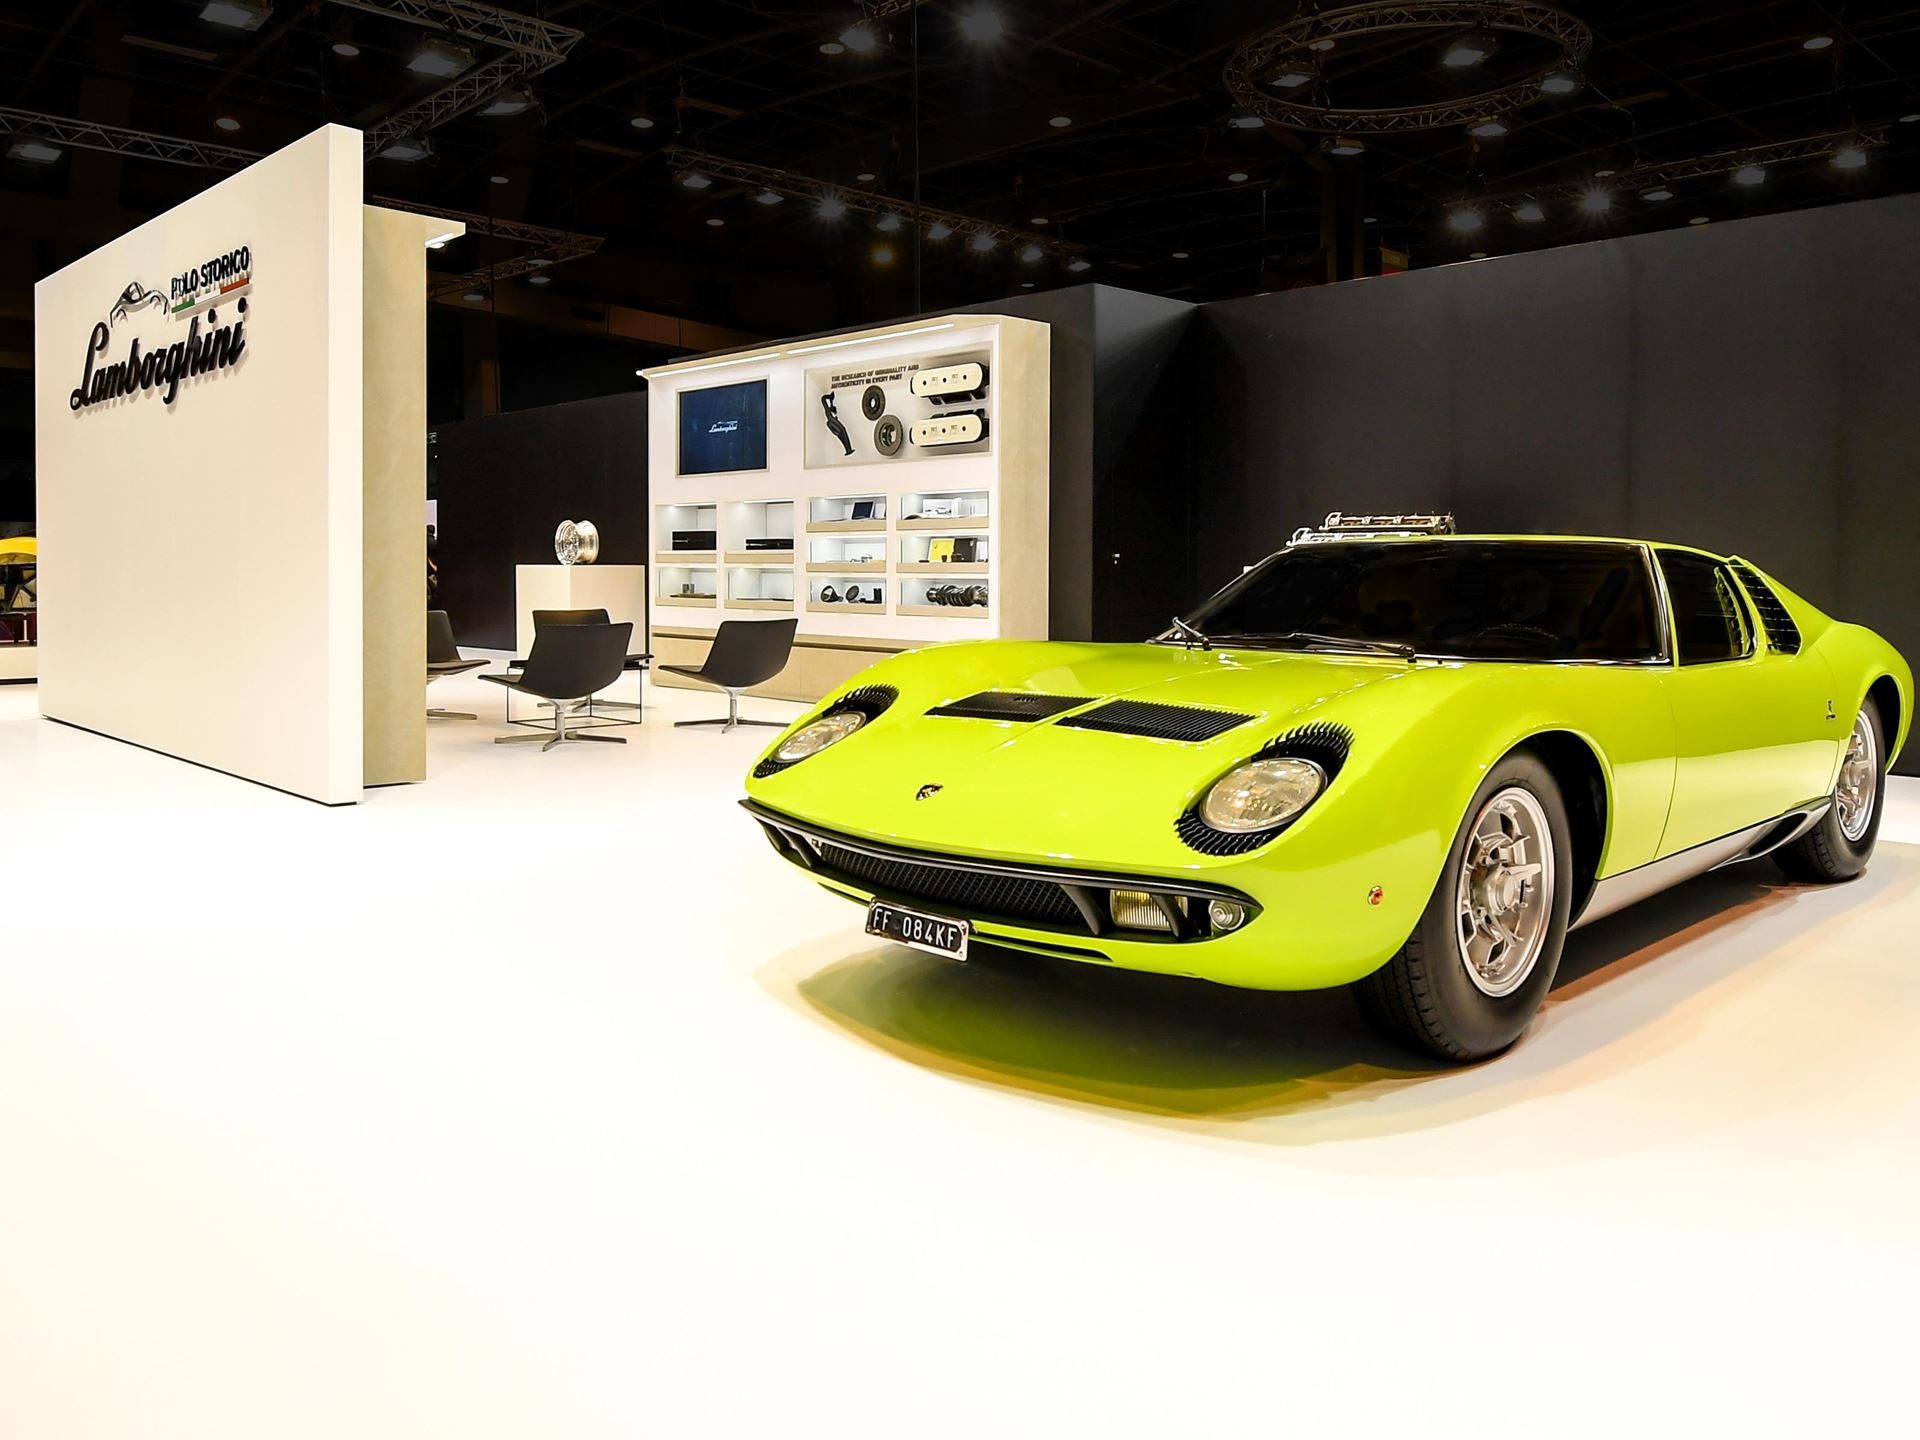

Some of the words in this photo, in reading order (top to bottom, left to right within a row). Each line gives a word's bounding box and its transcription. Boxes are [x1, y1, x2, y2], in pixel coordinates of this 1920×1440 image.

[171, 269, 198, 299] POLO
[200, 246, 249, 288] STORICO
[70, 297, 246, 410] Lamborghini
[873, 908, 892, 930] FF
[903, 916, 957, 948] 084KF
